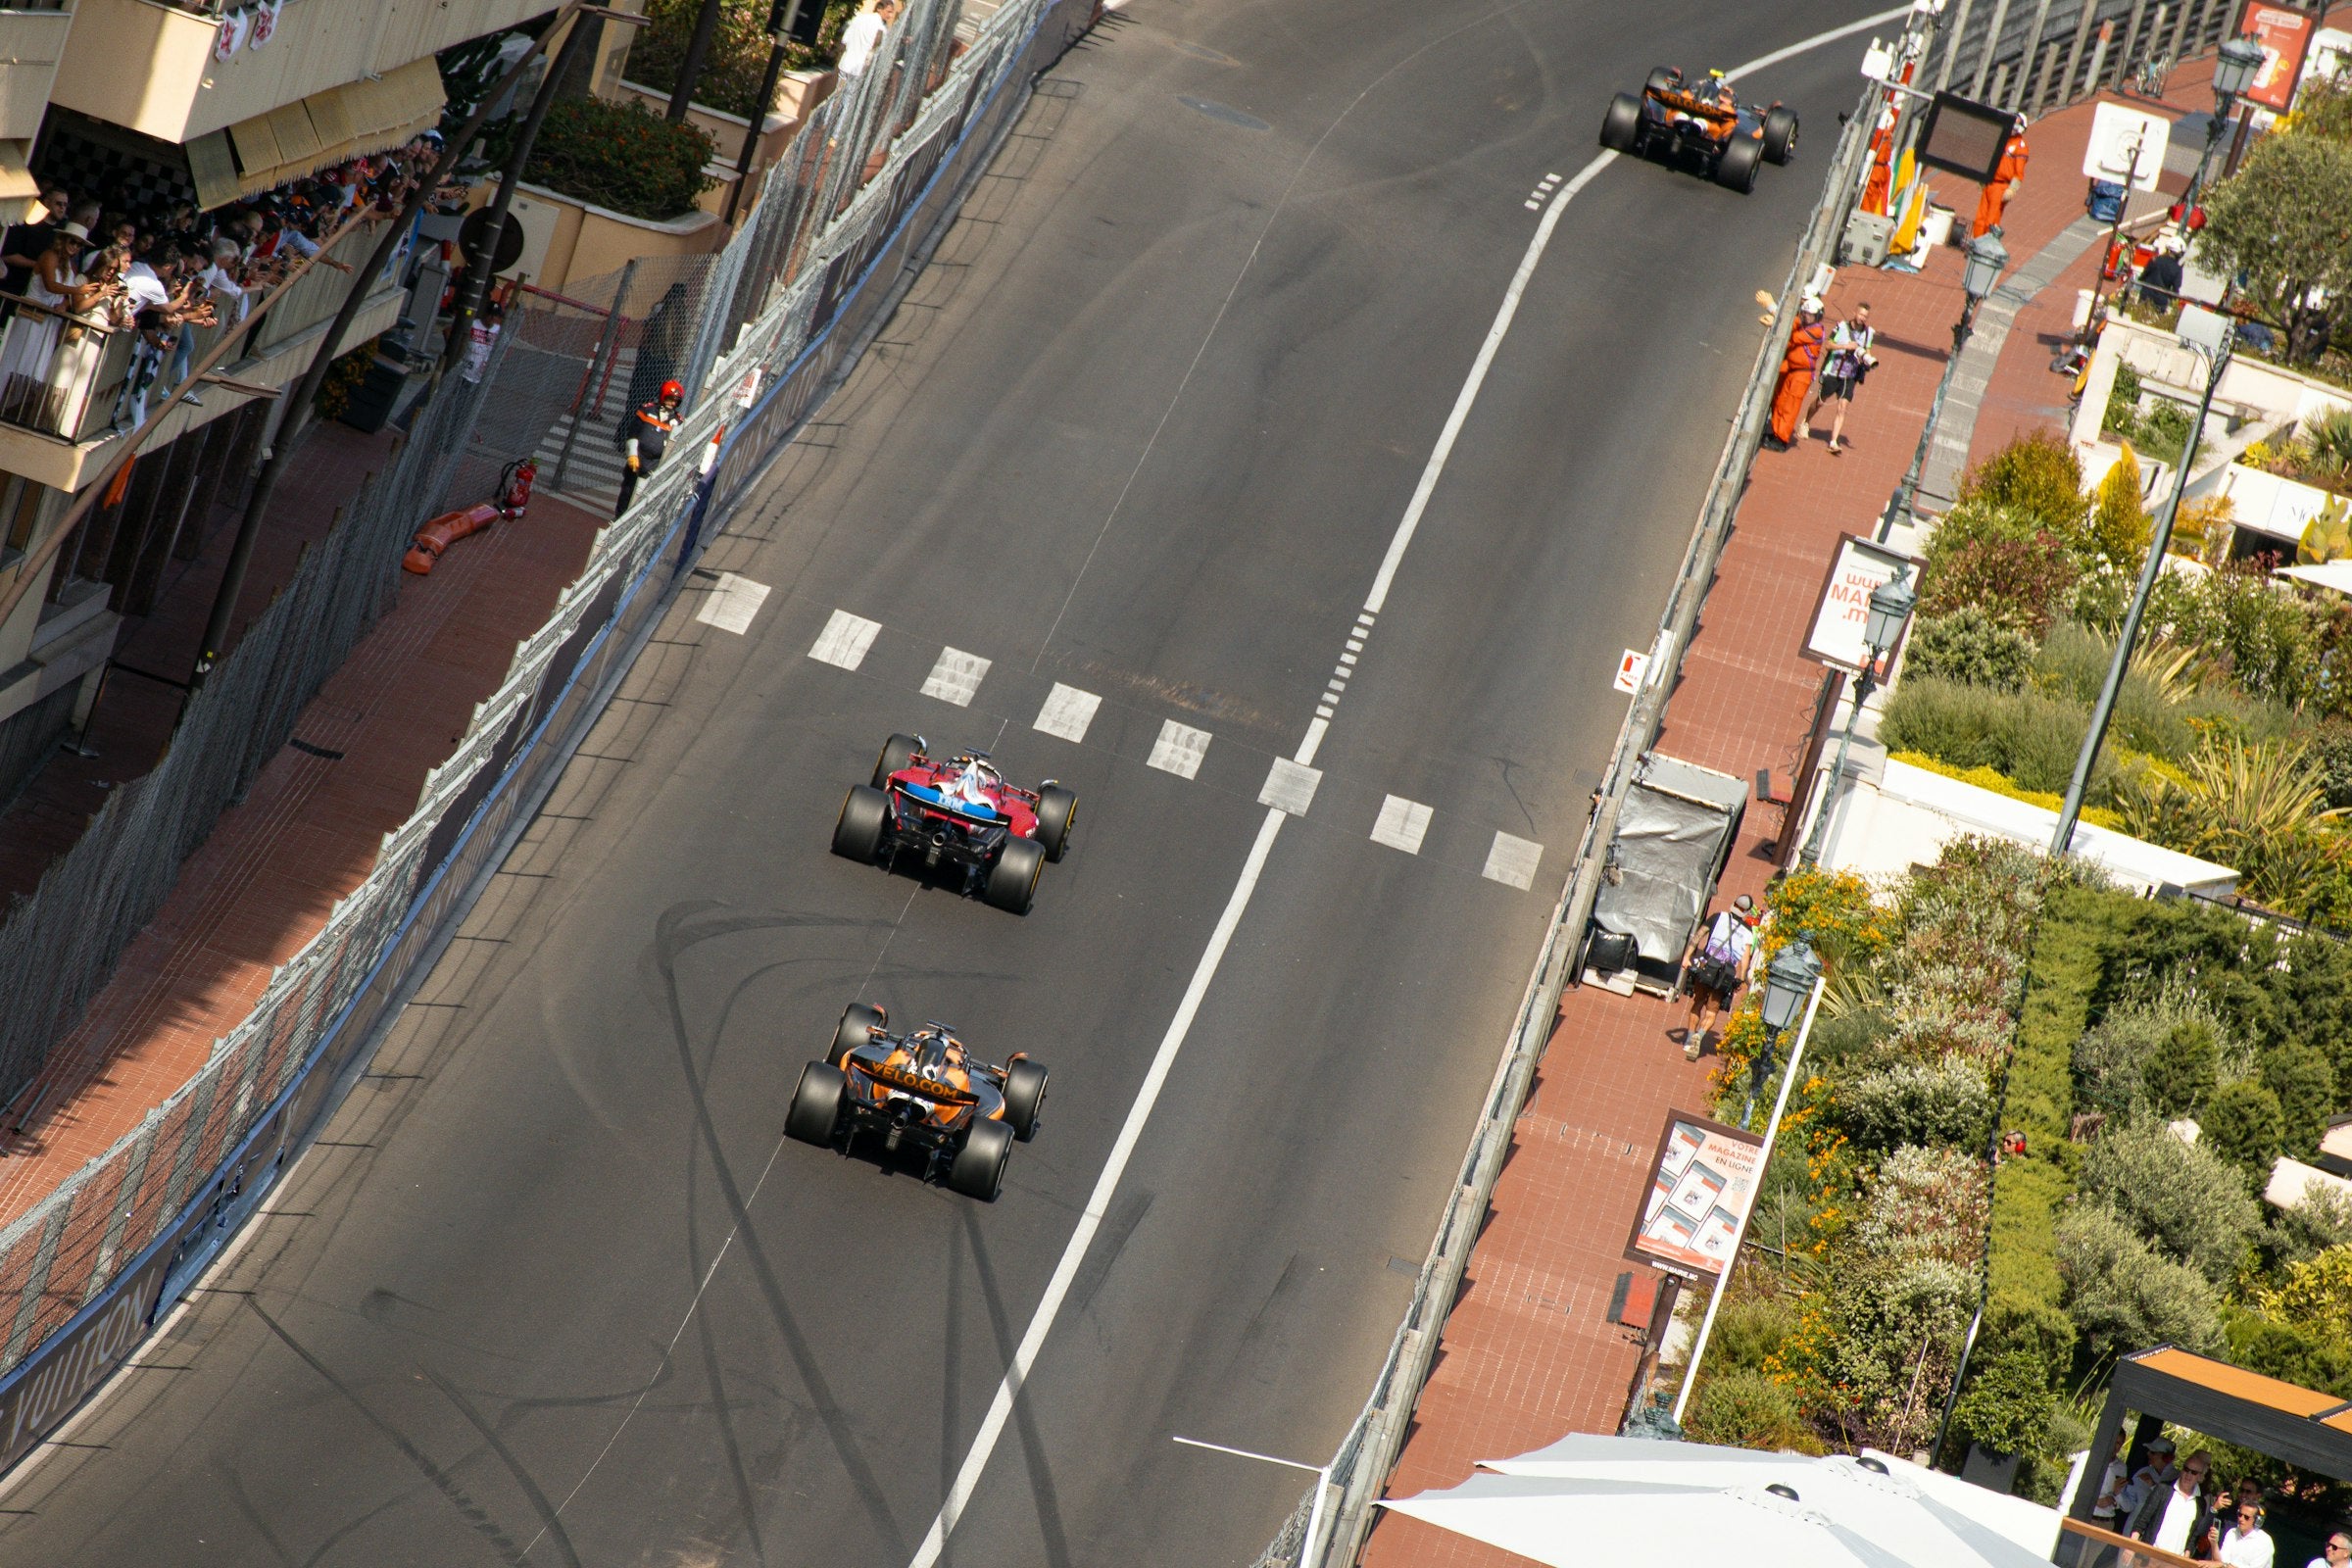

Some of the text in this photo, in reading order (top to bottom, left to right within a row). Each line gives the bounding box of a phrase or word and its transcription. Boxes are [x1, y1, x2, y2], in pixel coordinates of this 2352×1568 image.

[871, 1061, 958, 1099] VELO.COM
[1708, 1144, 1757, 1164] MAGAZINE
[1732, 1140, 1759, 1155] VOTRE
[1715, 1156, 1754, 1174] EN LIGNE
[9, 1266, 155, 1449] VUITTON
